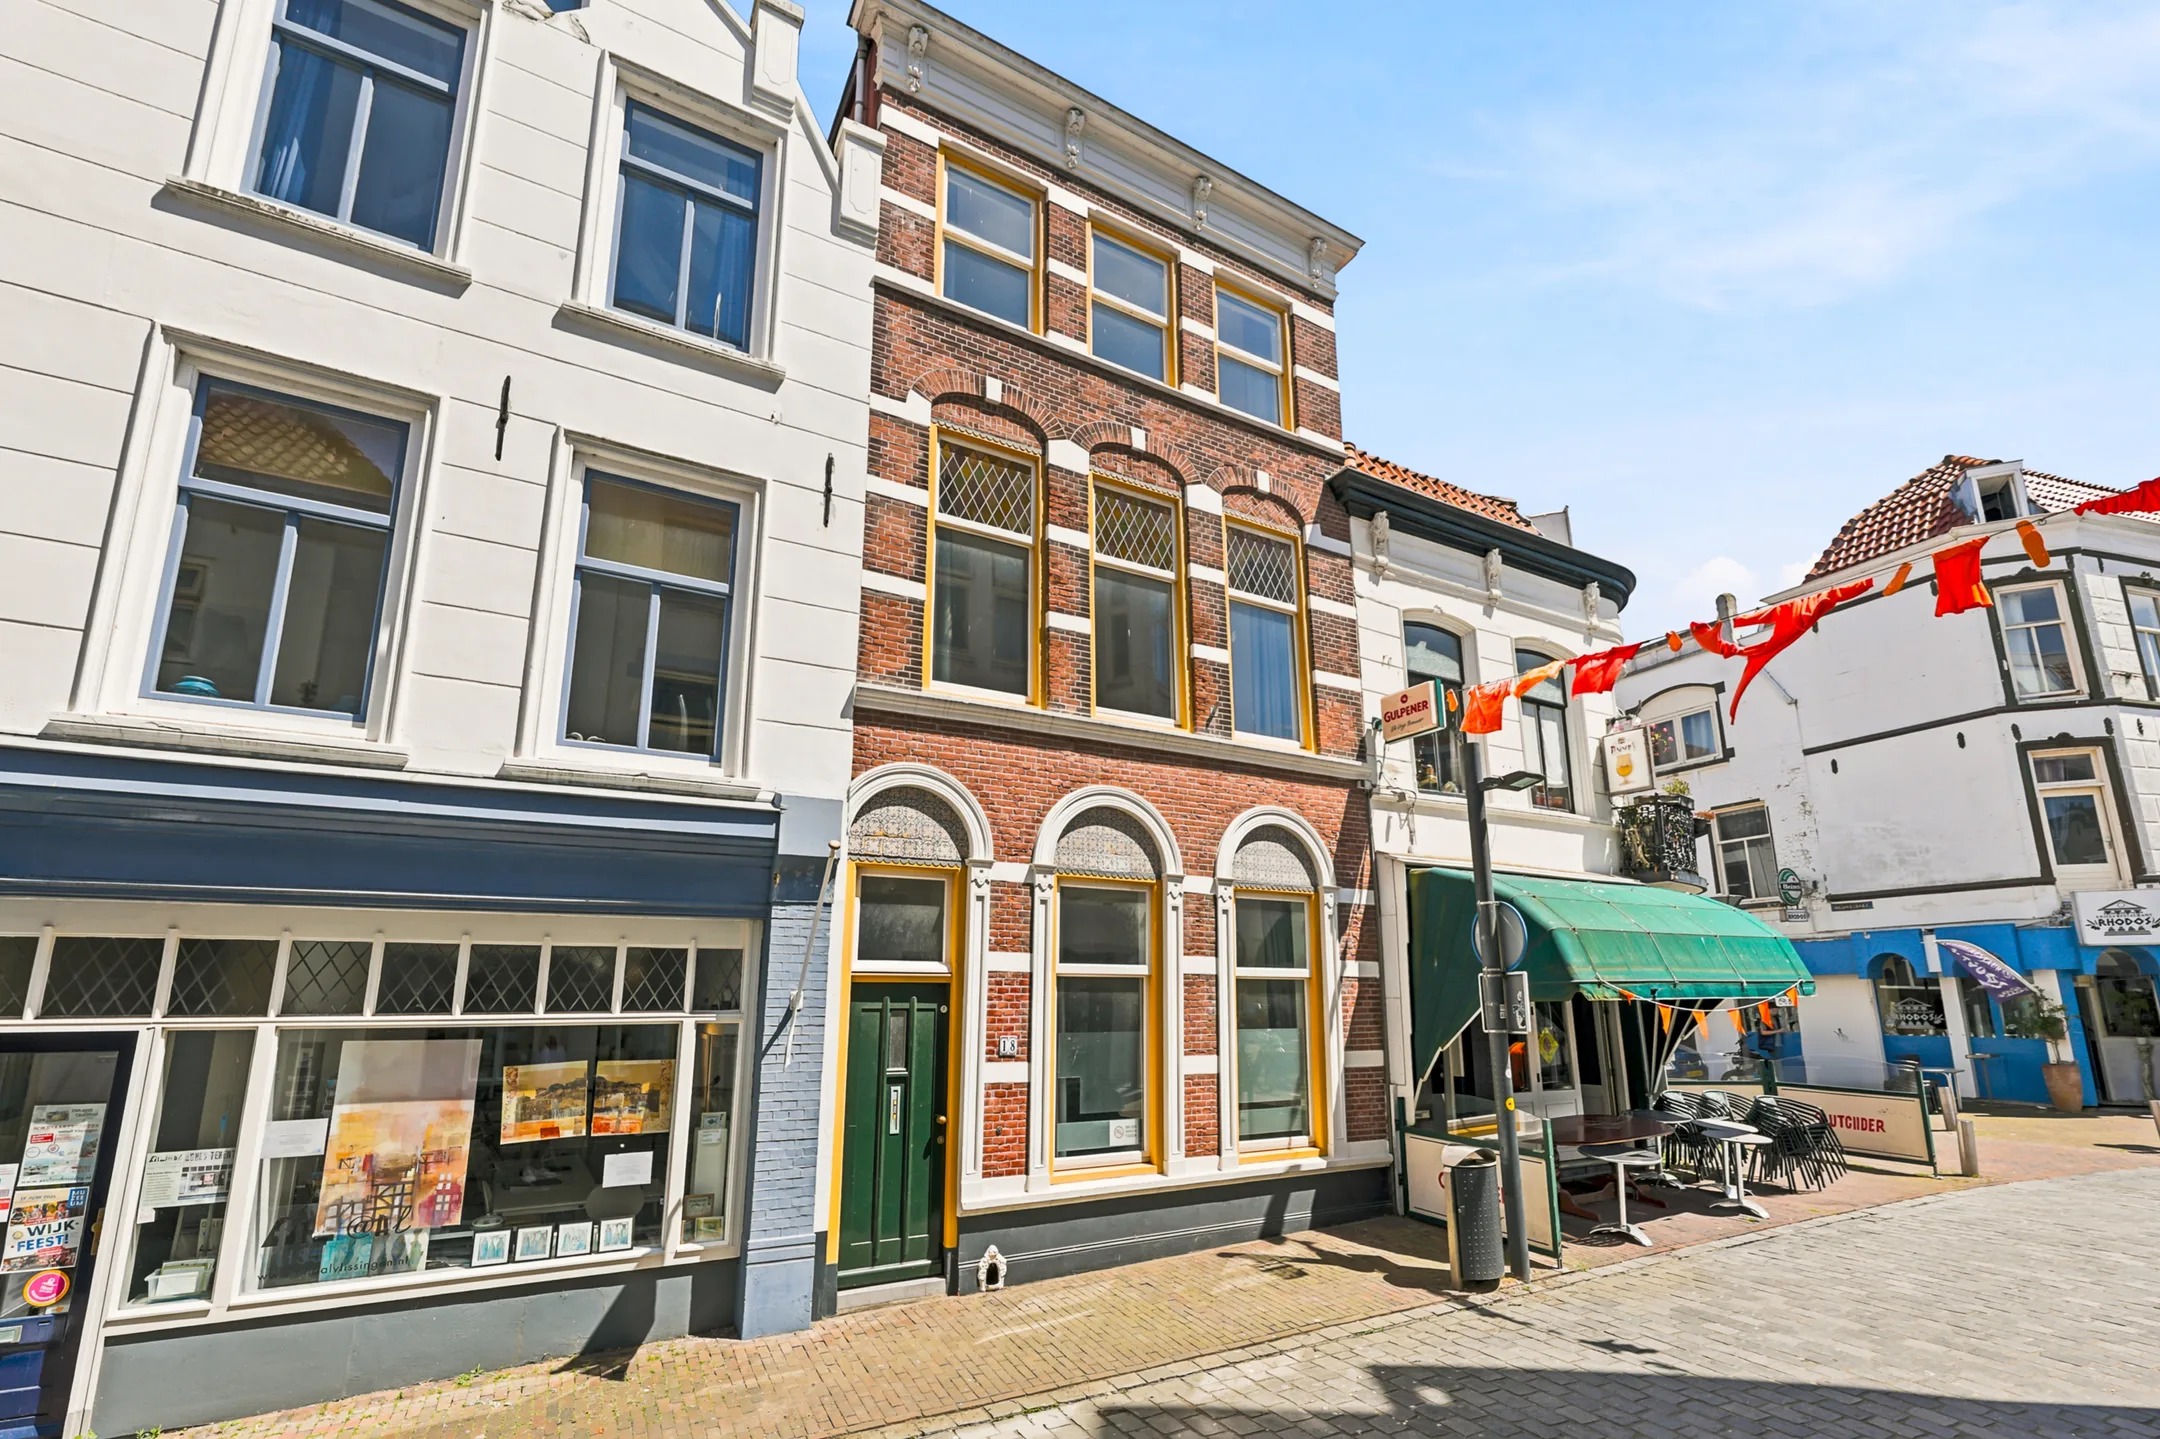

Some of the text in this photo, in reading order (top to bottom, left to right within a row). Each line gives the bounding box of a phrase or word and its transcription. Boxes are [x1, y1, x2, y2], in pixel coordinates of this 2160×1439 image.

[1383, 700, 1429, 723] GULPENER
[2098, 917, 2151, 927] RHODOS
[1896, 1013, 1934, 1021] RHODOS
[1002, 1040, 1016, 1052] 18
[1815, 1112, 1886, 1133] UTCIIDER
[27, 1220, 75, 1237] WIJK
[17, 1234, 69, 1252] FEEST!
